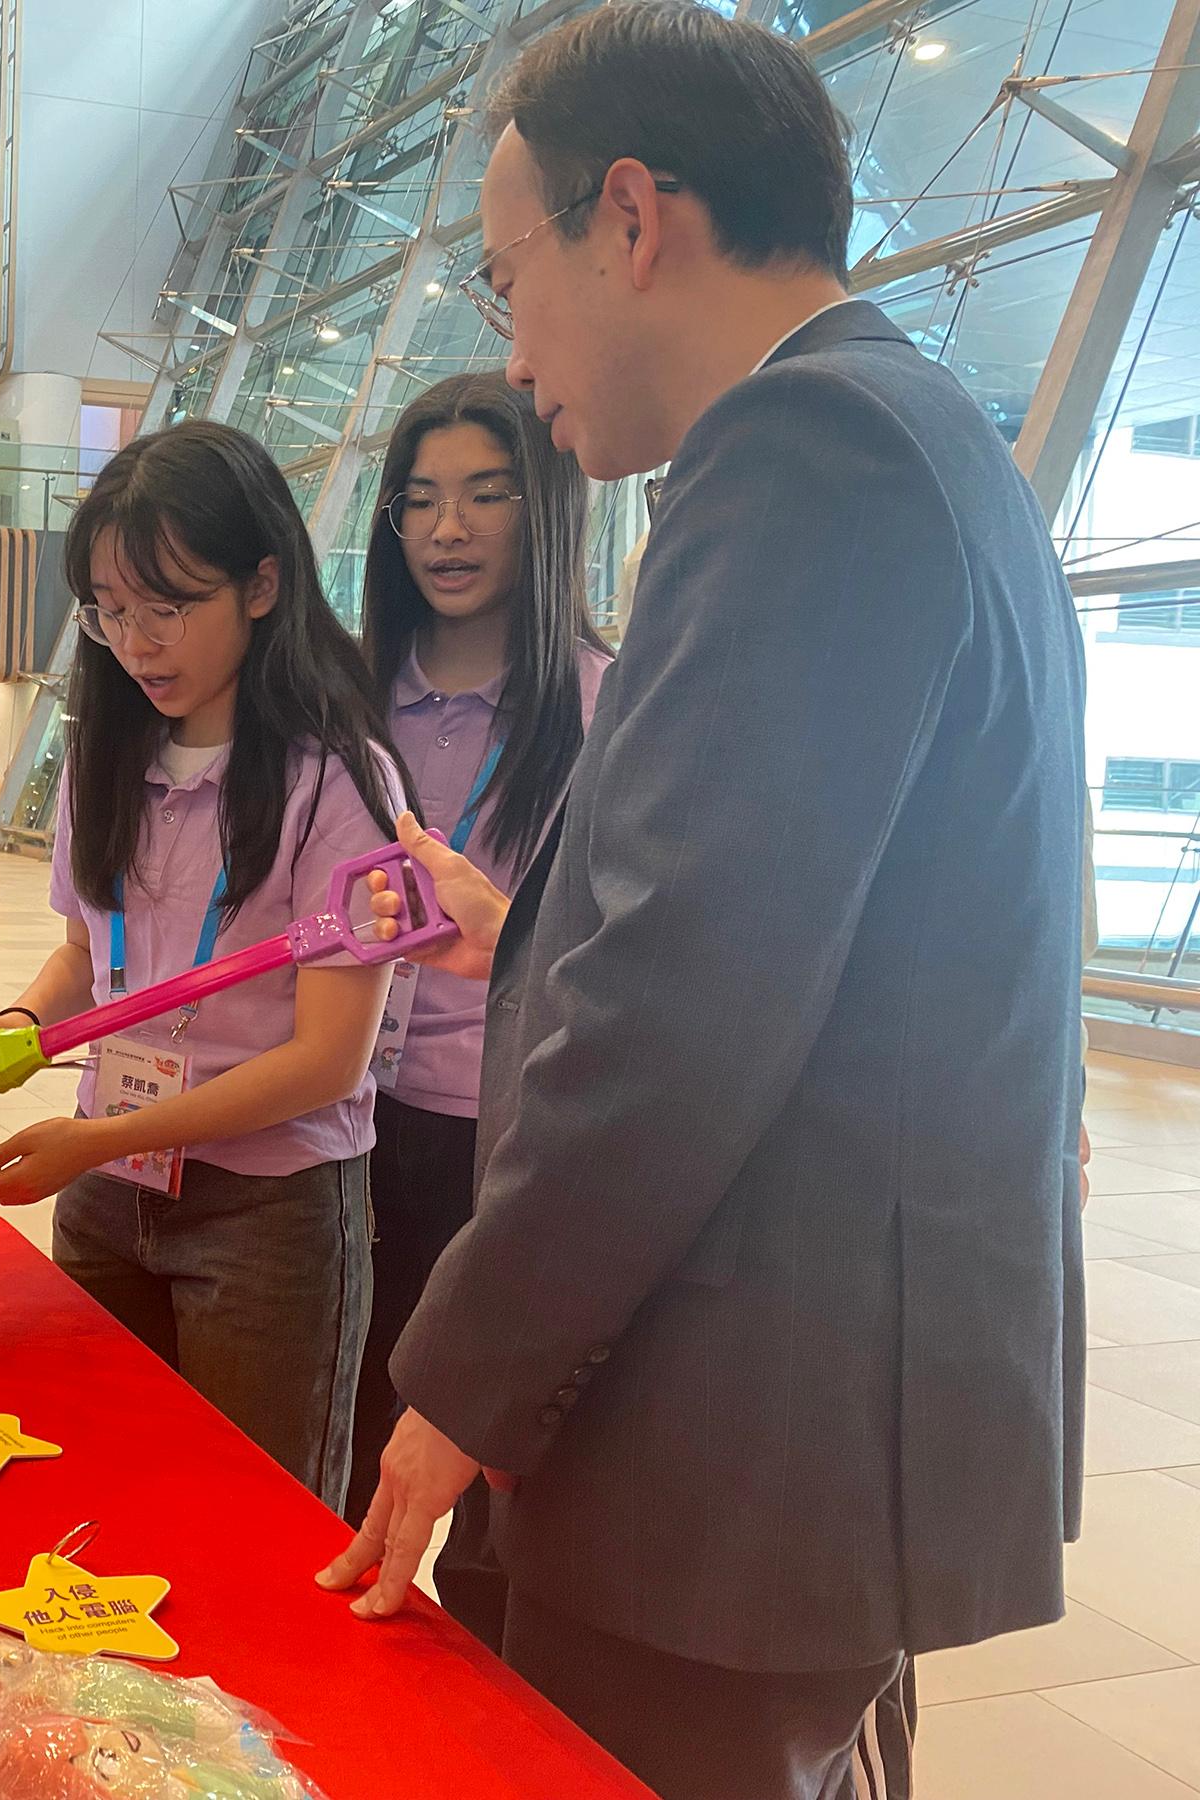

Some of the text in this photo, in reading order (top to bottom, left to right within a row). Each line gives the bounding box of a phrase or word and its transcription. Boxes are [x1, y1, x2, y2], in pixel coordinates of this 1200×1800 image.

[44, 1583, 100, 1604] 入侵
[23, 1599, 140, 1627] 他人電腦
[39, 1626, 65, 1635] Hack
[87, 1617, 137, 1630] computers
[69, 1631, 94, 1640] other
[95, 1627, 128, 1637] people
